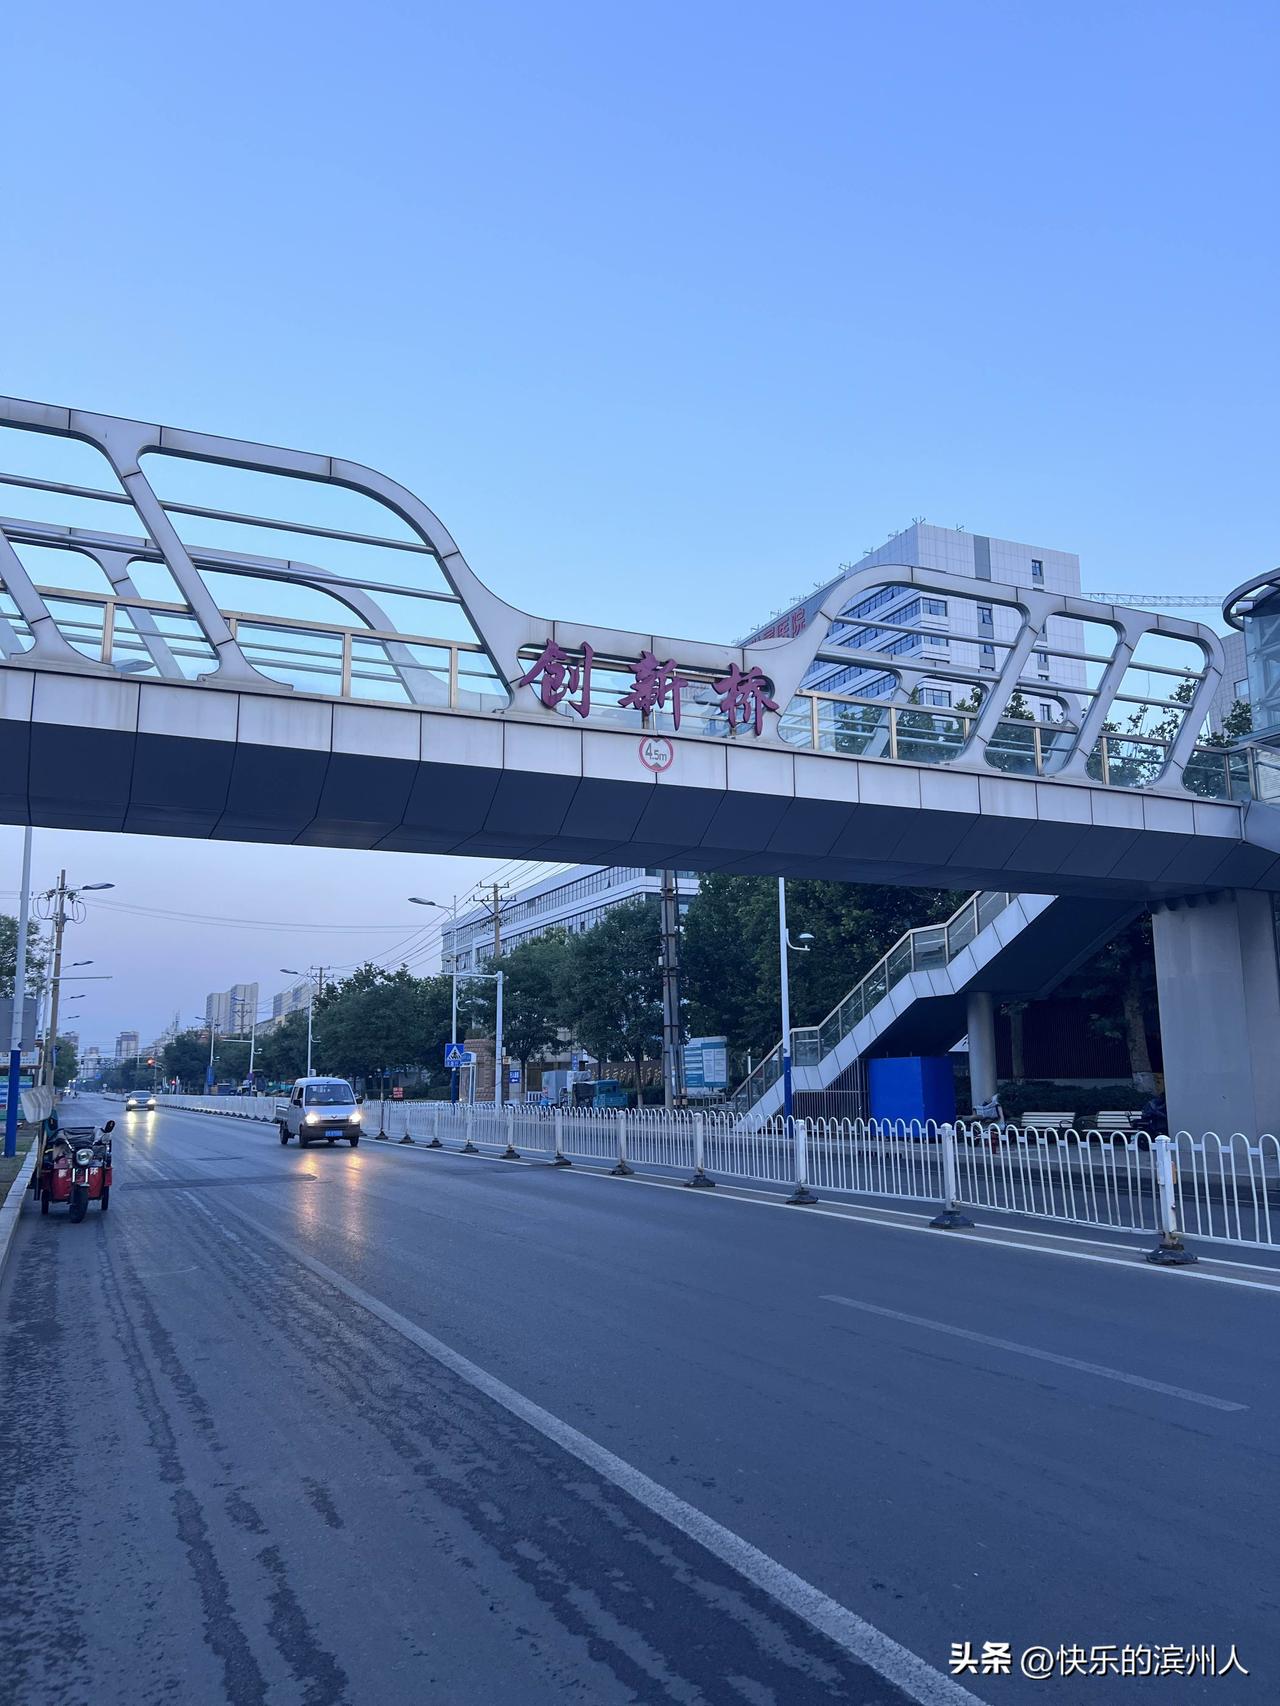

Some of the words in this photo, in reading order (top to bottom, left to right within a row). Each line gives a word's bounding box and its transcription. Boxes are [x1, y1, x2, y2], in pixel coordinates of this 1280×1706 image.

[519, 638, 780, 737] 创新桥
[645, 742, 668, 762] 4.5m
